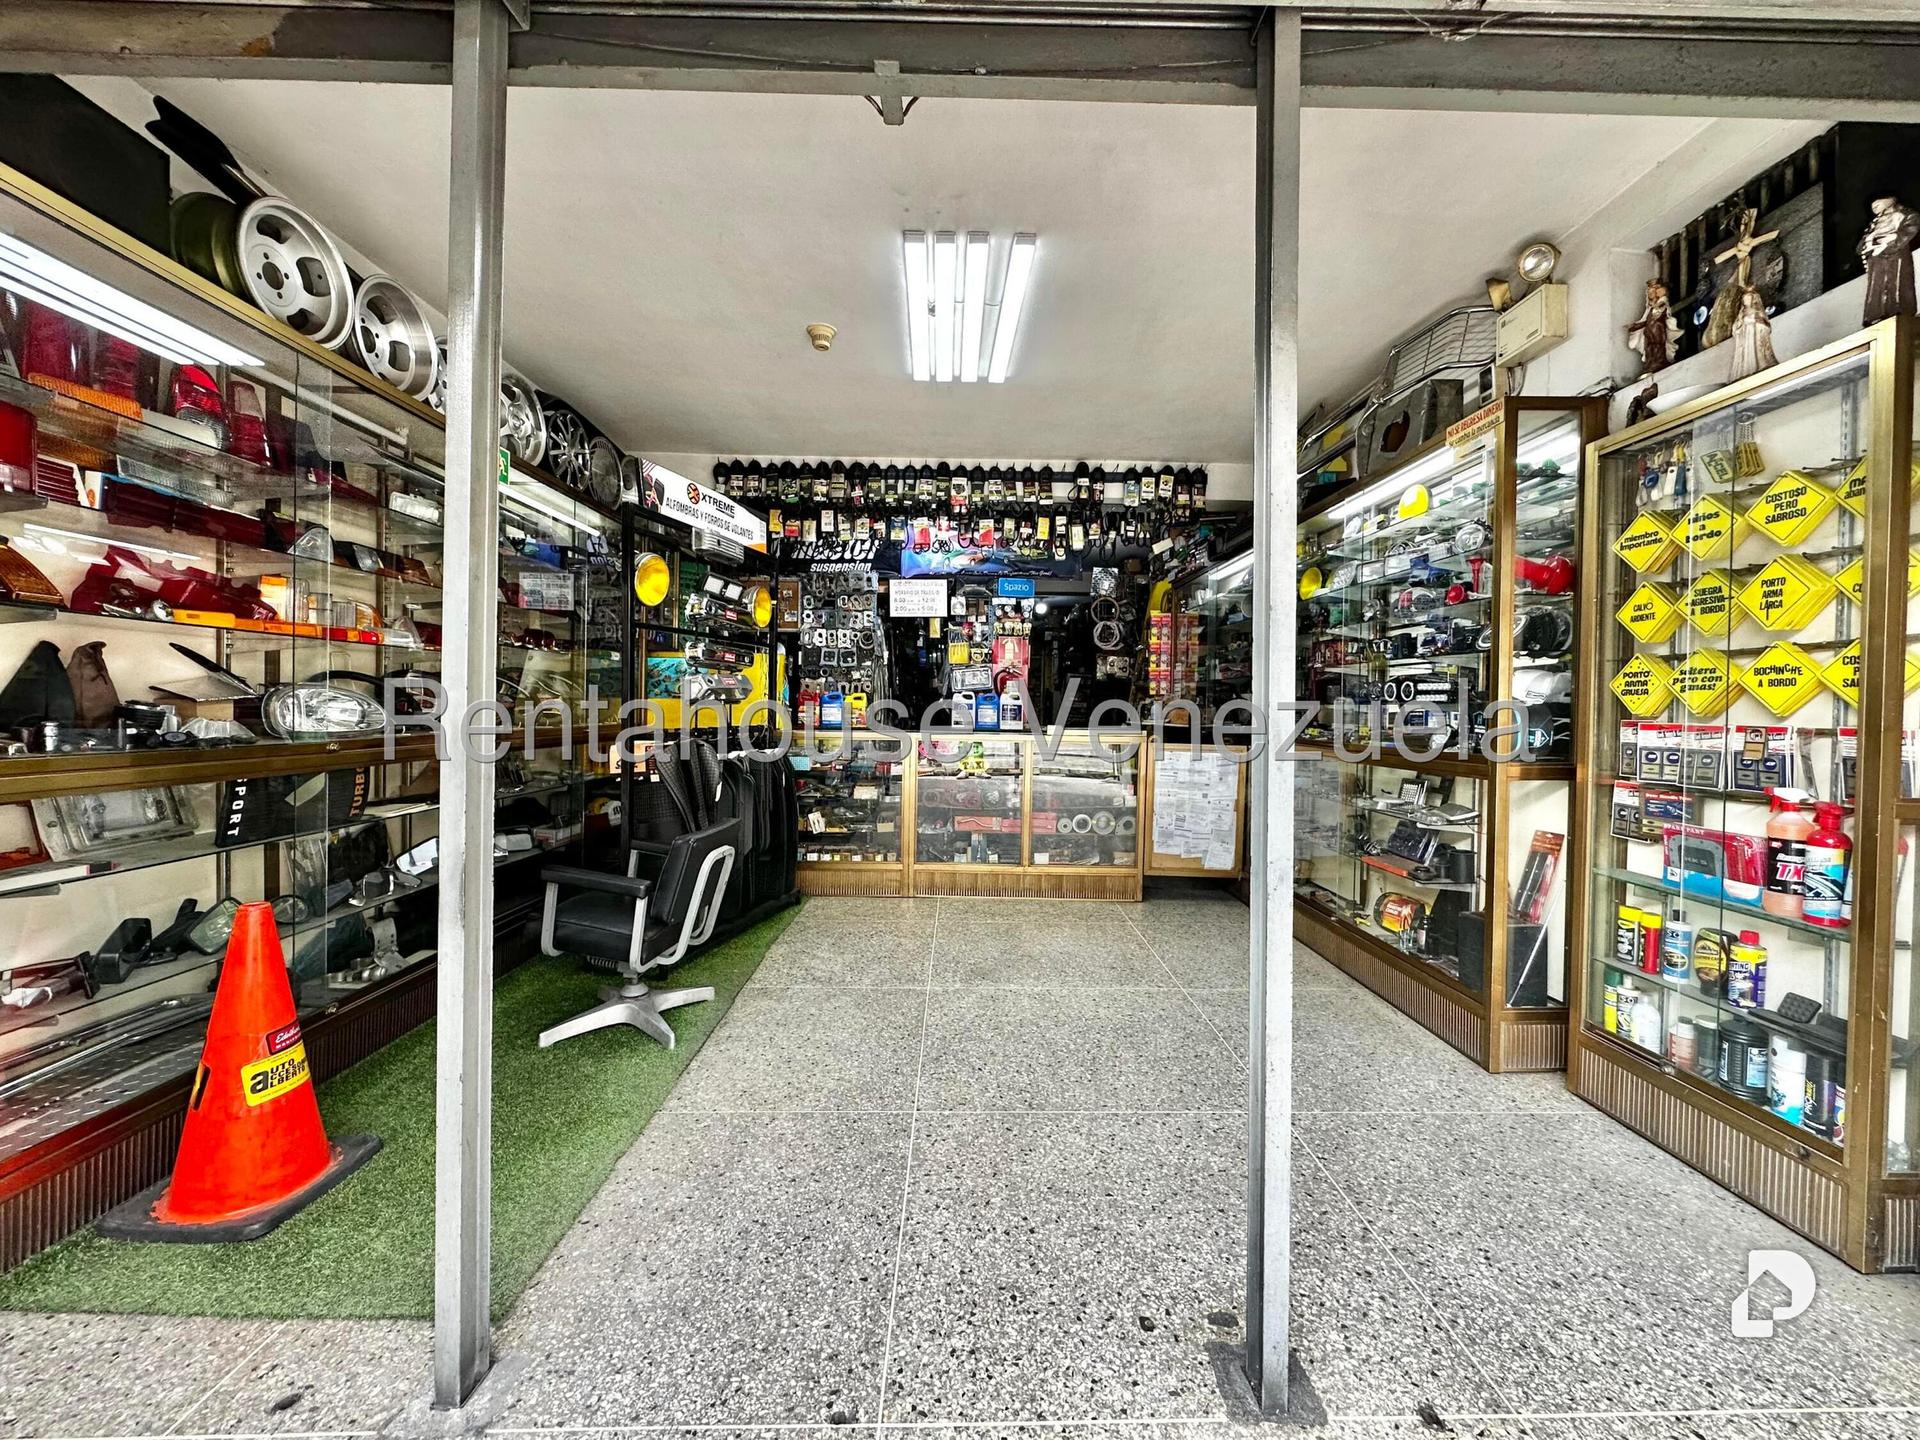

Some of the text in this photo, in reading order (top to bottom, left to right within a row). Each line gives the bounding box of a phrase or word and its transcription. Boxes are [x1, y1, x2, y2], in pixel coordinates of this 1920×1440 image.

[1765, 486, 1807, 504] COSTOSO
[701, 492, 735, 515] XTREME
[1773, 499, 1798, 513] PERO
[665, 497, 699, 519] ALFOMBRAS
[731, 522, 754, 541] VOLANTES
[1764, 507, 1807, 525] SABROSO
[1624, 530, 1659, 544] miembro
[810, 561, 872, 574] suspension
[1004, 582, 1029, 592] Spazio
[1760, 576, 1786, 588] PORTO
[1693, 586, 1723, 597] SUEGRA
[1761, 588, 1783, 599] ARMA
[1633, 602, 1653, 611] CALVO
[1690, 595, 1726, 607] AGRESIVA
[1759, 599, 1783, 611] LARGA
[1690, 605, 1726, 617] A BORDO
[1630, 612, 1656, 623] ARDIENTE
[1622, 670, 1650, 679] PORTO
[1753, 663, 1804, 677] BOCHINCHE
[1624, 679, 1648, 687] ARMA
[1700, 674, 1723, 684] con
[1757, 677, 1797, 688] A BORDO
[1620, 688, 1650, 697] GRUESA
